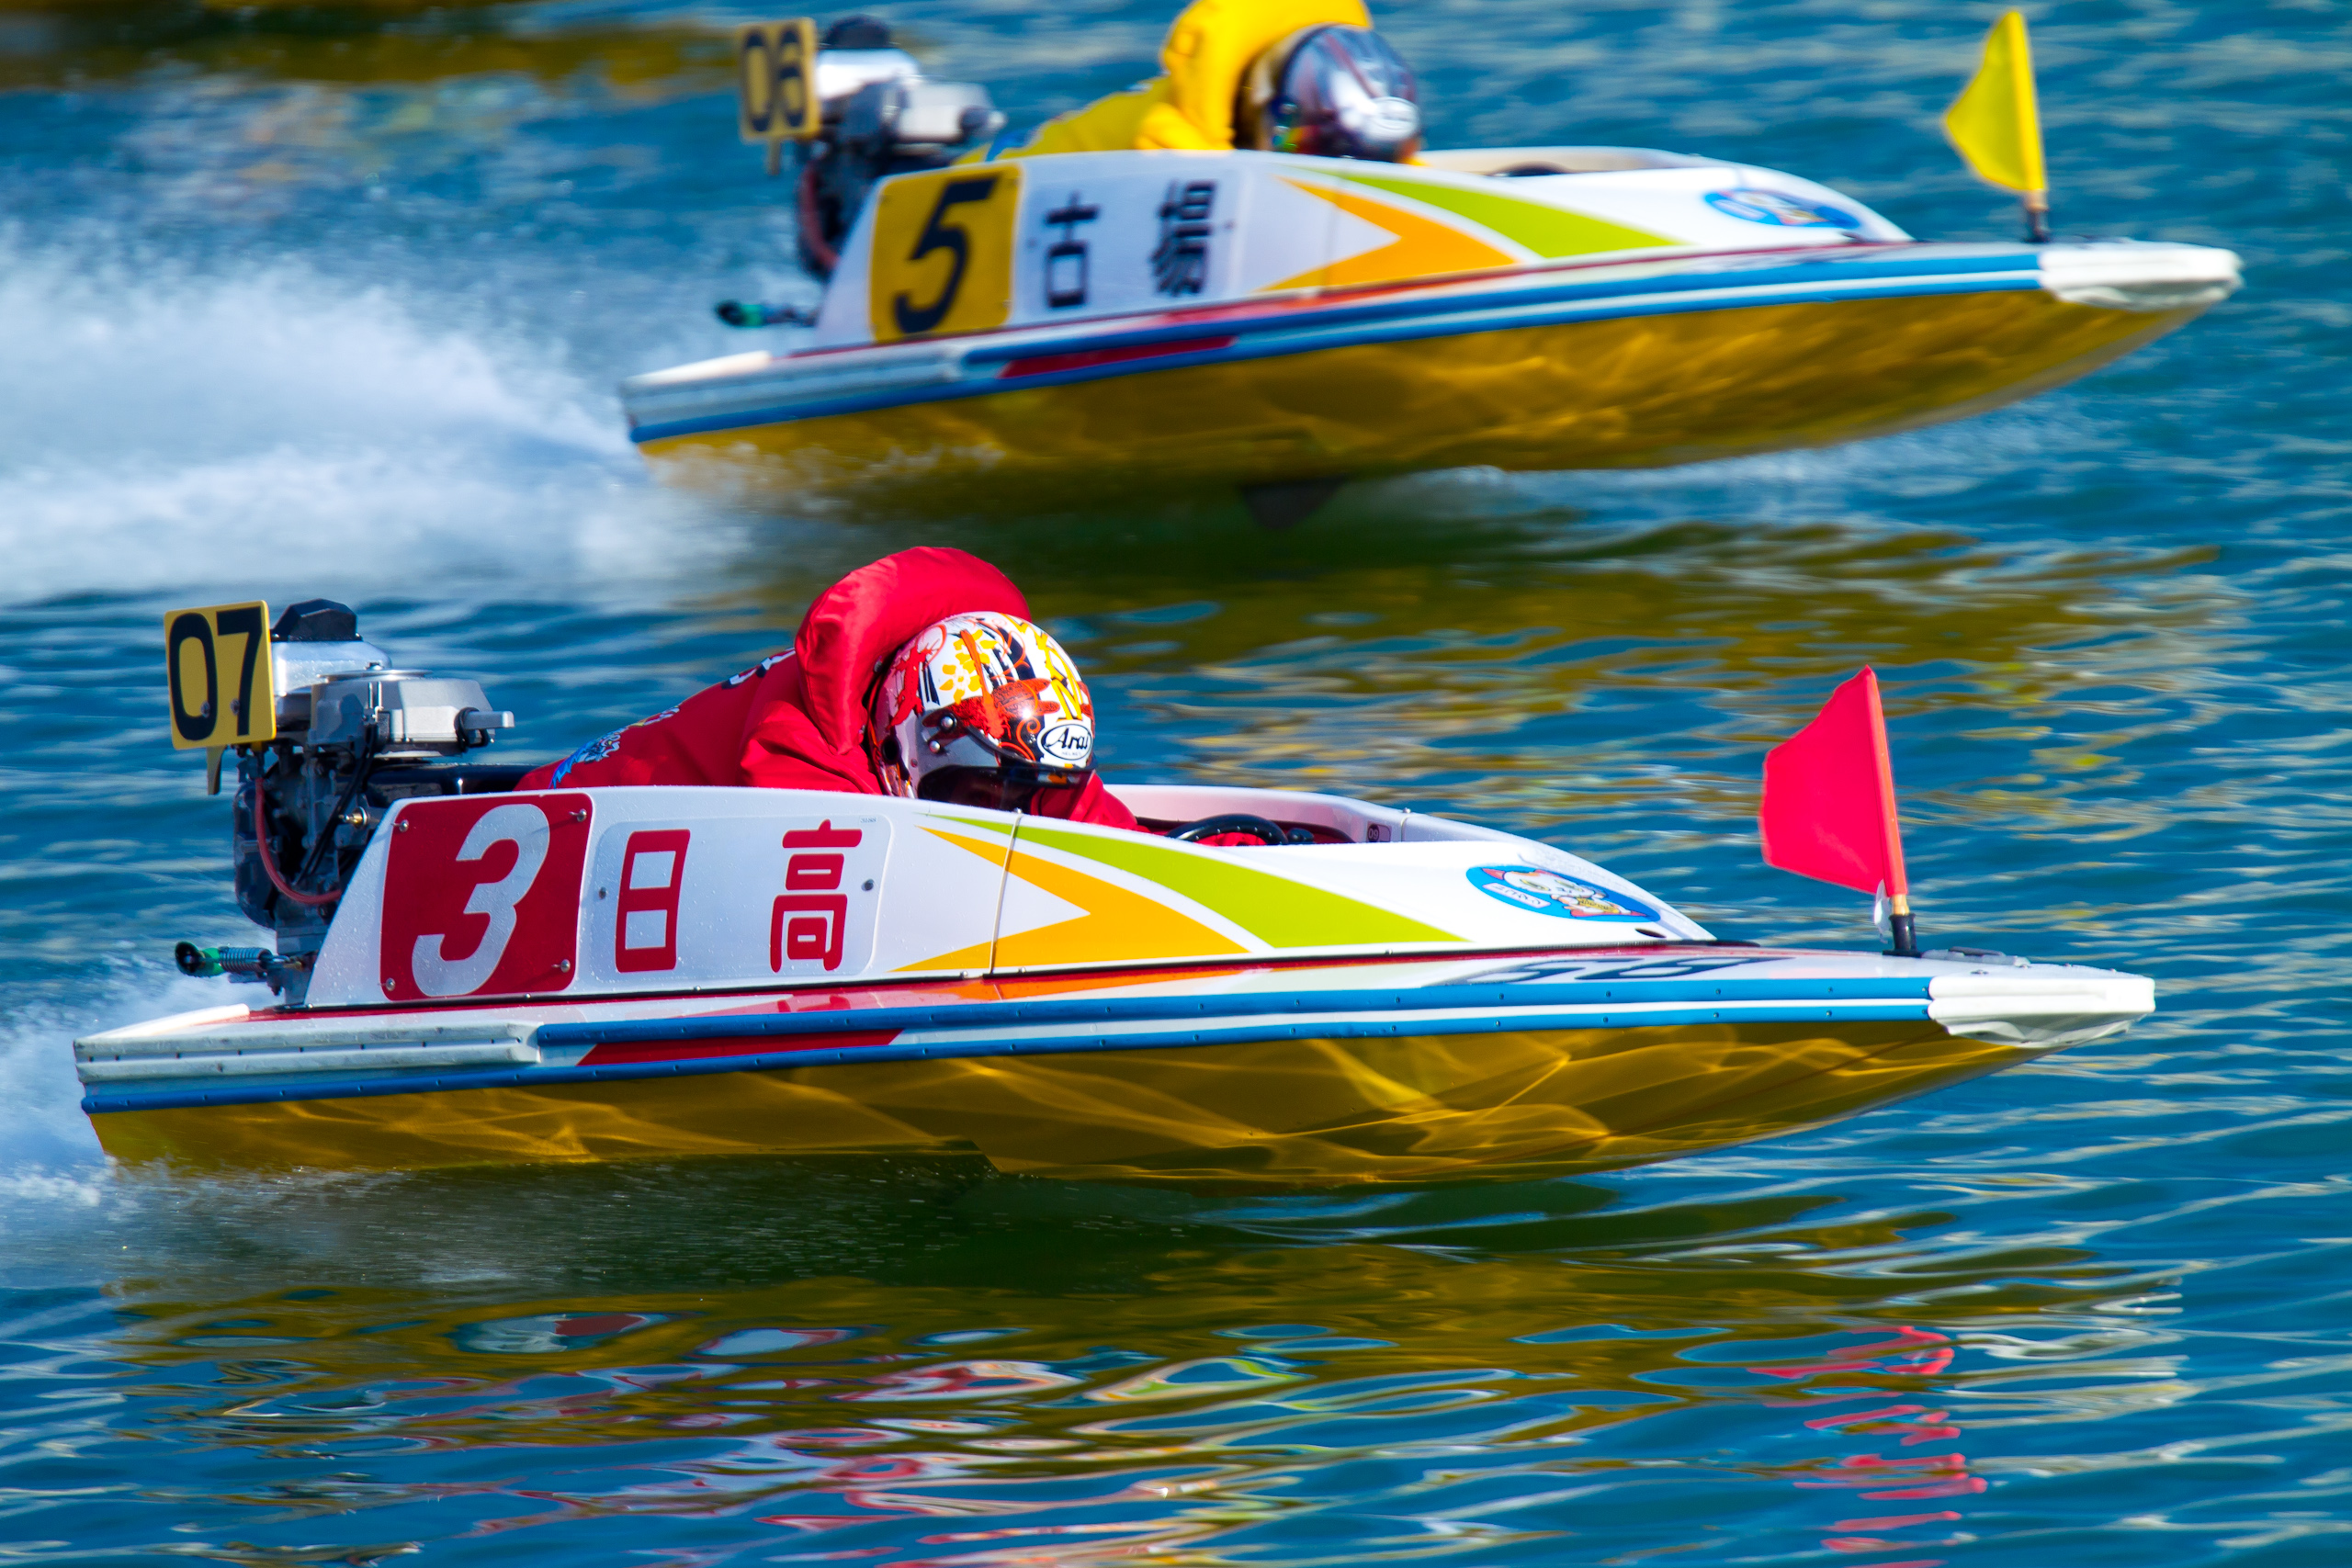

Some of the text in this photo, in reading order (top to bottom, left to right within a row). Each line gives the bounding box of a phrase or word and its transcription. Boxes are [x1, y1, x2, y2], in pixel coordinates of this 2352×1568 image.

[743, 24, 806, 132] 06
[893, 176, 1000, 334] 5
[168, 606, 262, 740] 07
[412, 803, 550, 997] 3
[615, 818, 863, 973] 日高
